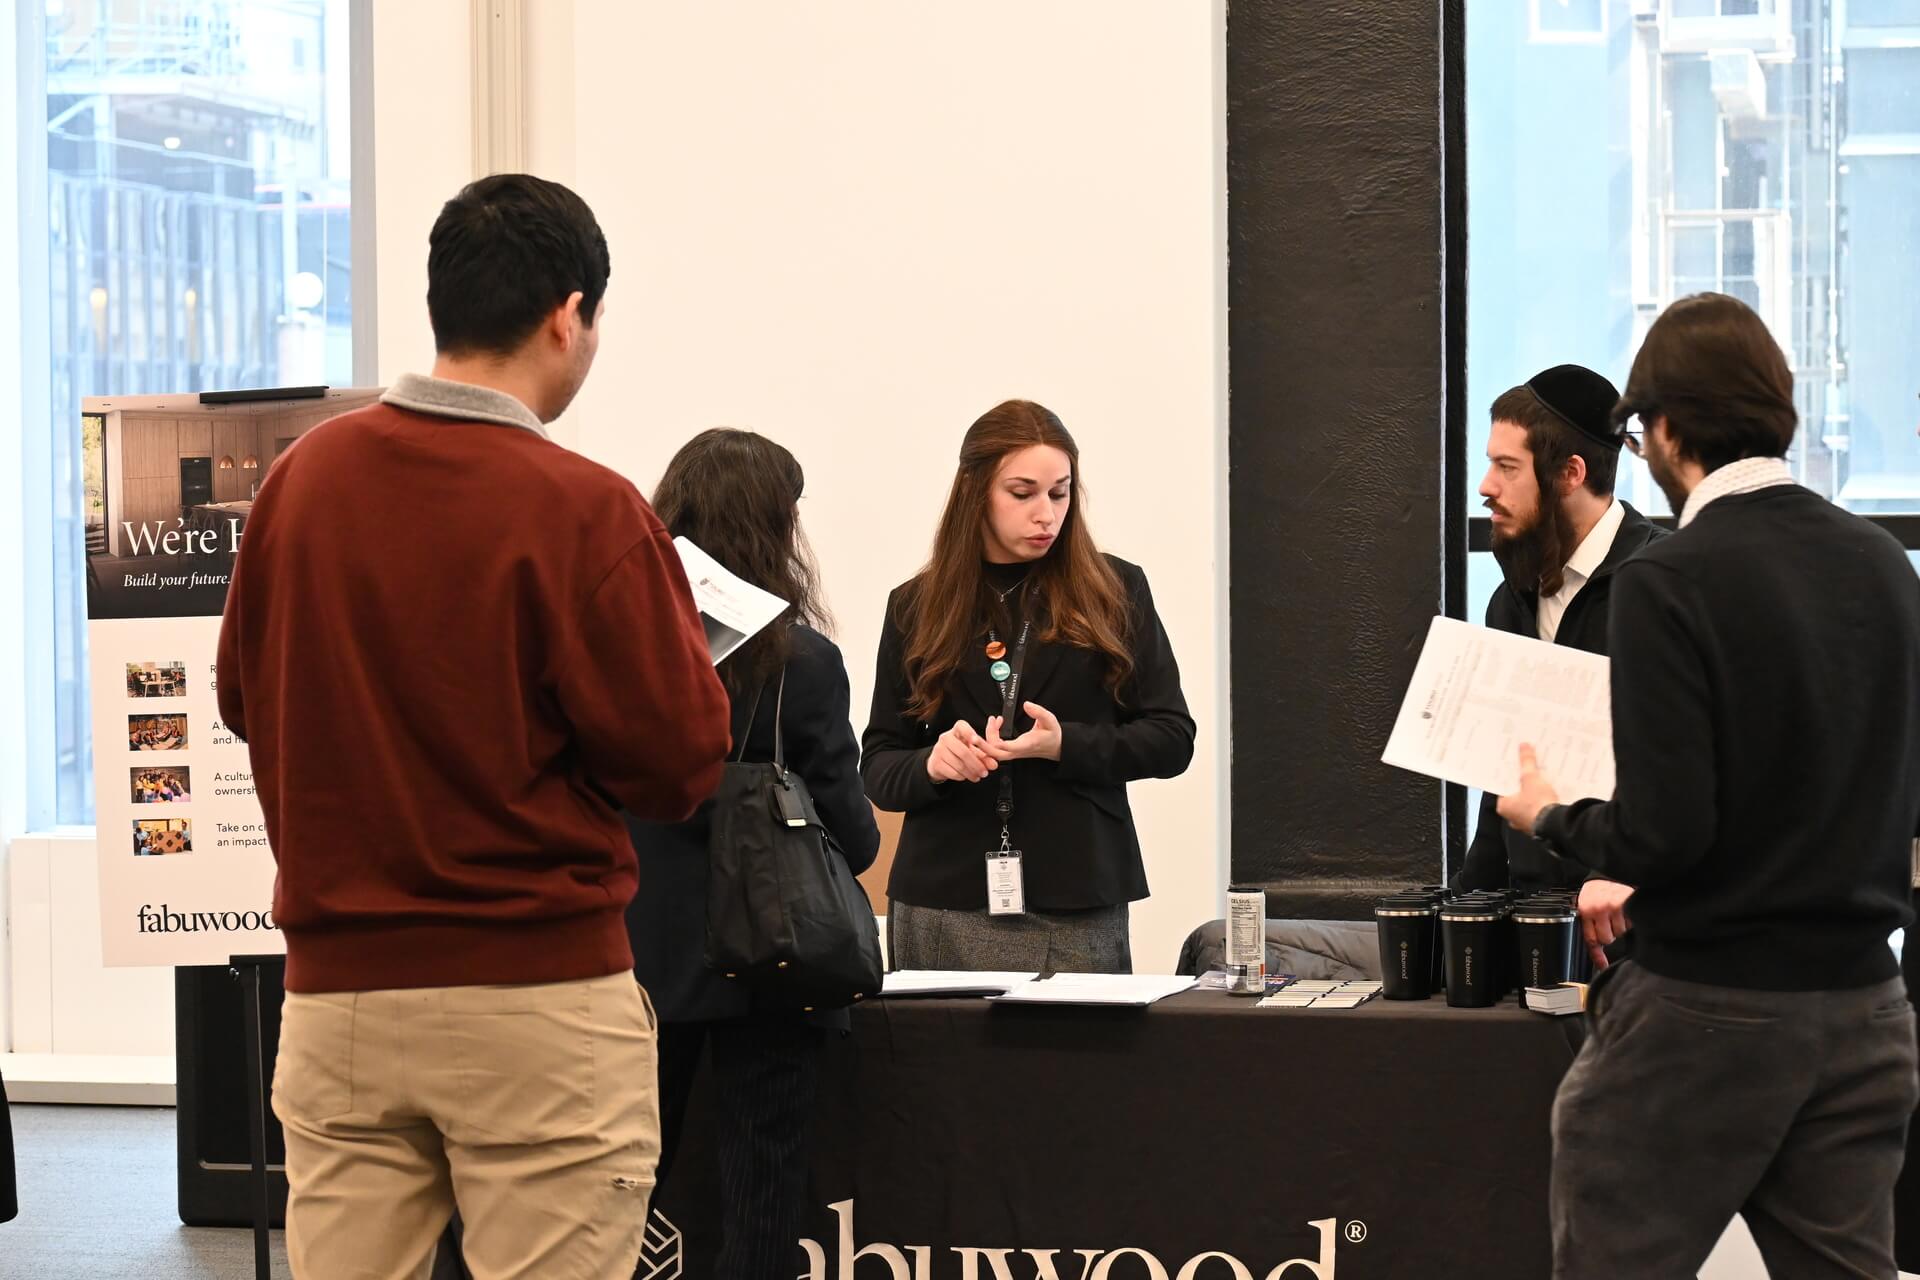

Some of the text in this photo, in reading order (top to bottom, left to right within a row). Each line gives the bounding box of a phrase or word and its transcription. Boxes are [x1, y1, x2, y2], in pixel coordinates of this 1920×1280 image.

[121, 517, 218, 556] We're
[123, 571, 231, 590] Build your future.
[212, 721, 220, 730] A
[212, 735, 232, 744] and
[214, 772, 222, 781] A
[216, 822, 239, 832] Take
[242, 824, 255, 832] on
[217, 836, 267, 848] an impact
